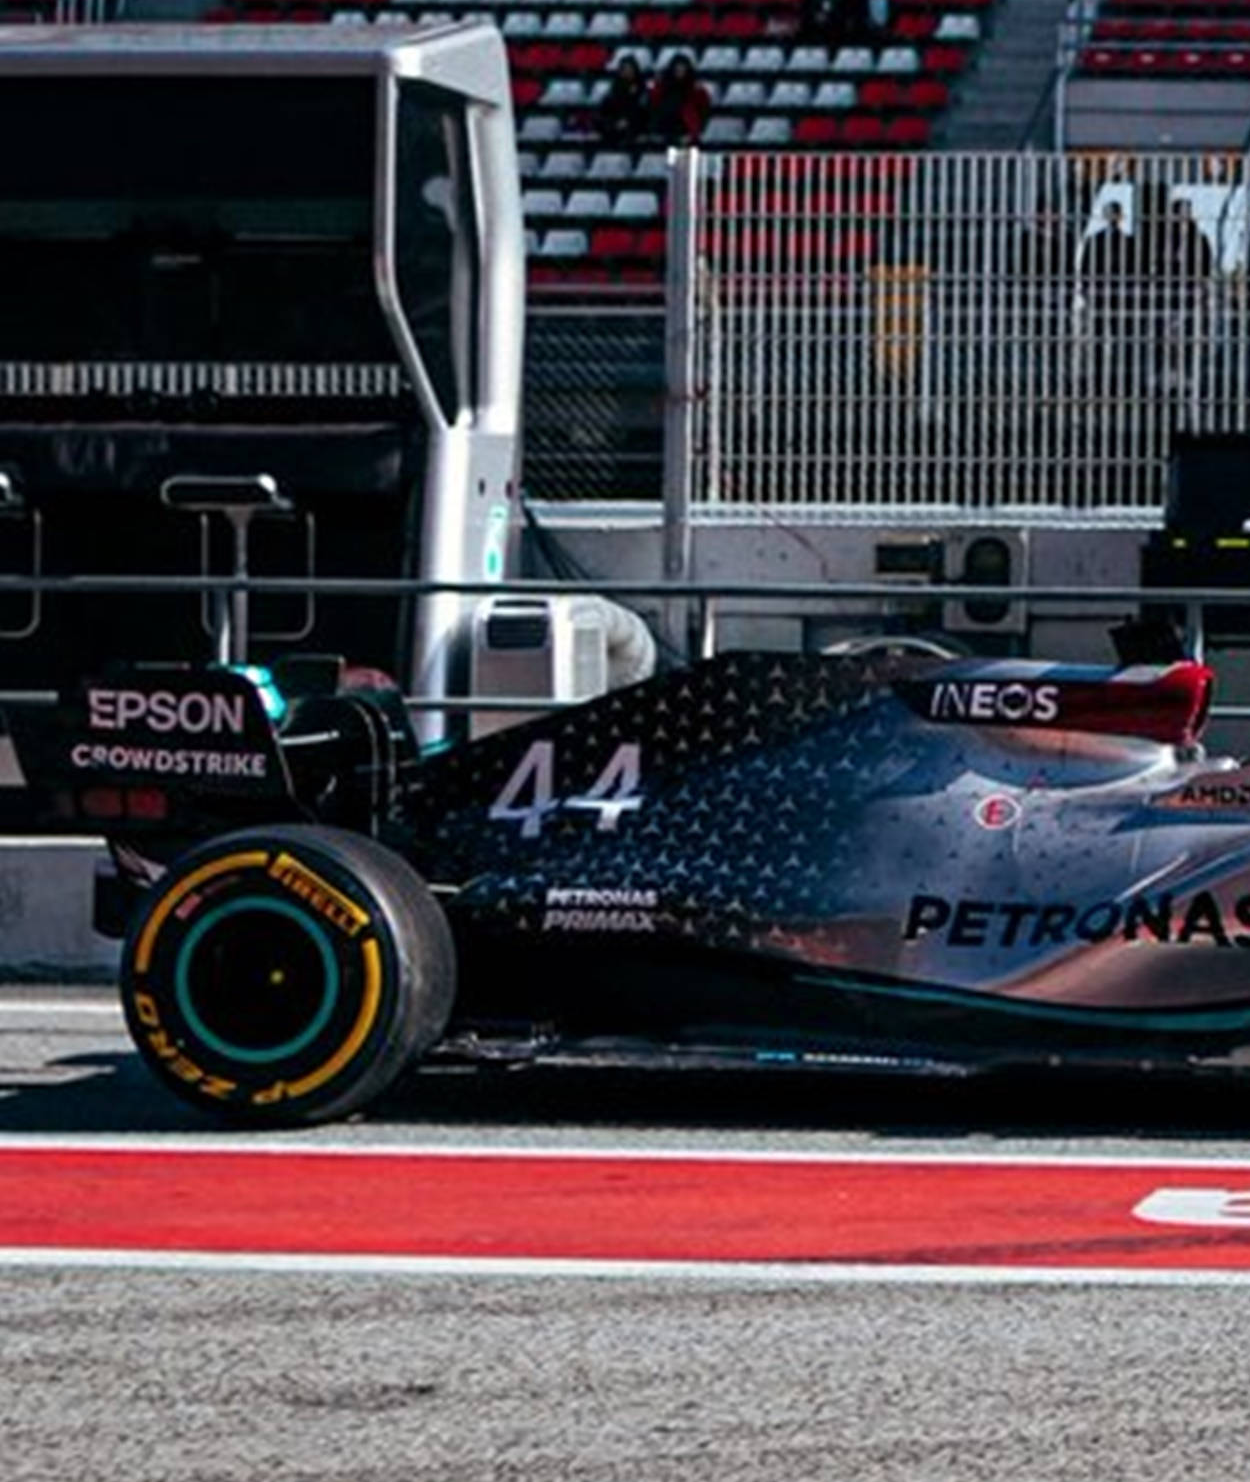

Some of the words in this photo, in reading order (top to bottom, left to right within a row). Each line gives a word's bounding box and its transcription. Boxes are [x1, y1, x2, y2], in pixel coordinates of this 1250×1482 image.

[89, 689, 244, 732] EPSON
[931, 684, 1058, 719] INEOS
[71, 744, 266, 777] CROWDSTRIKE
[489, 740, 643, 838] 44
[546, 888, 657, 906] PETRONAS
[543, 910, 656, 932] PRIMAX
